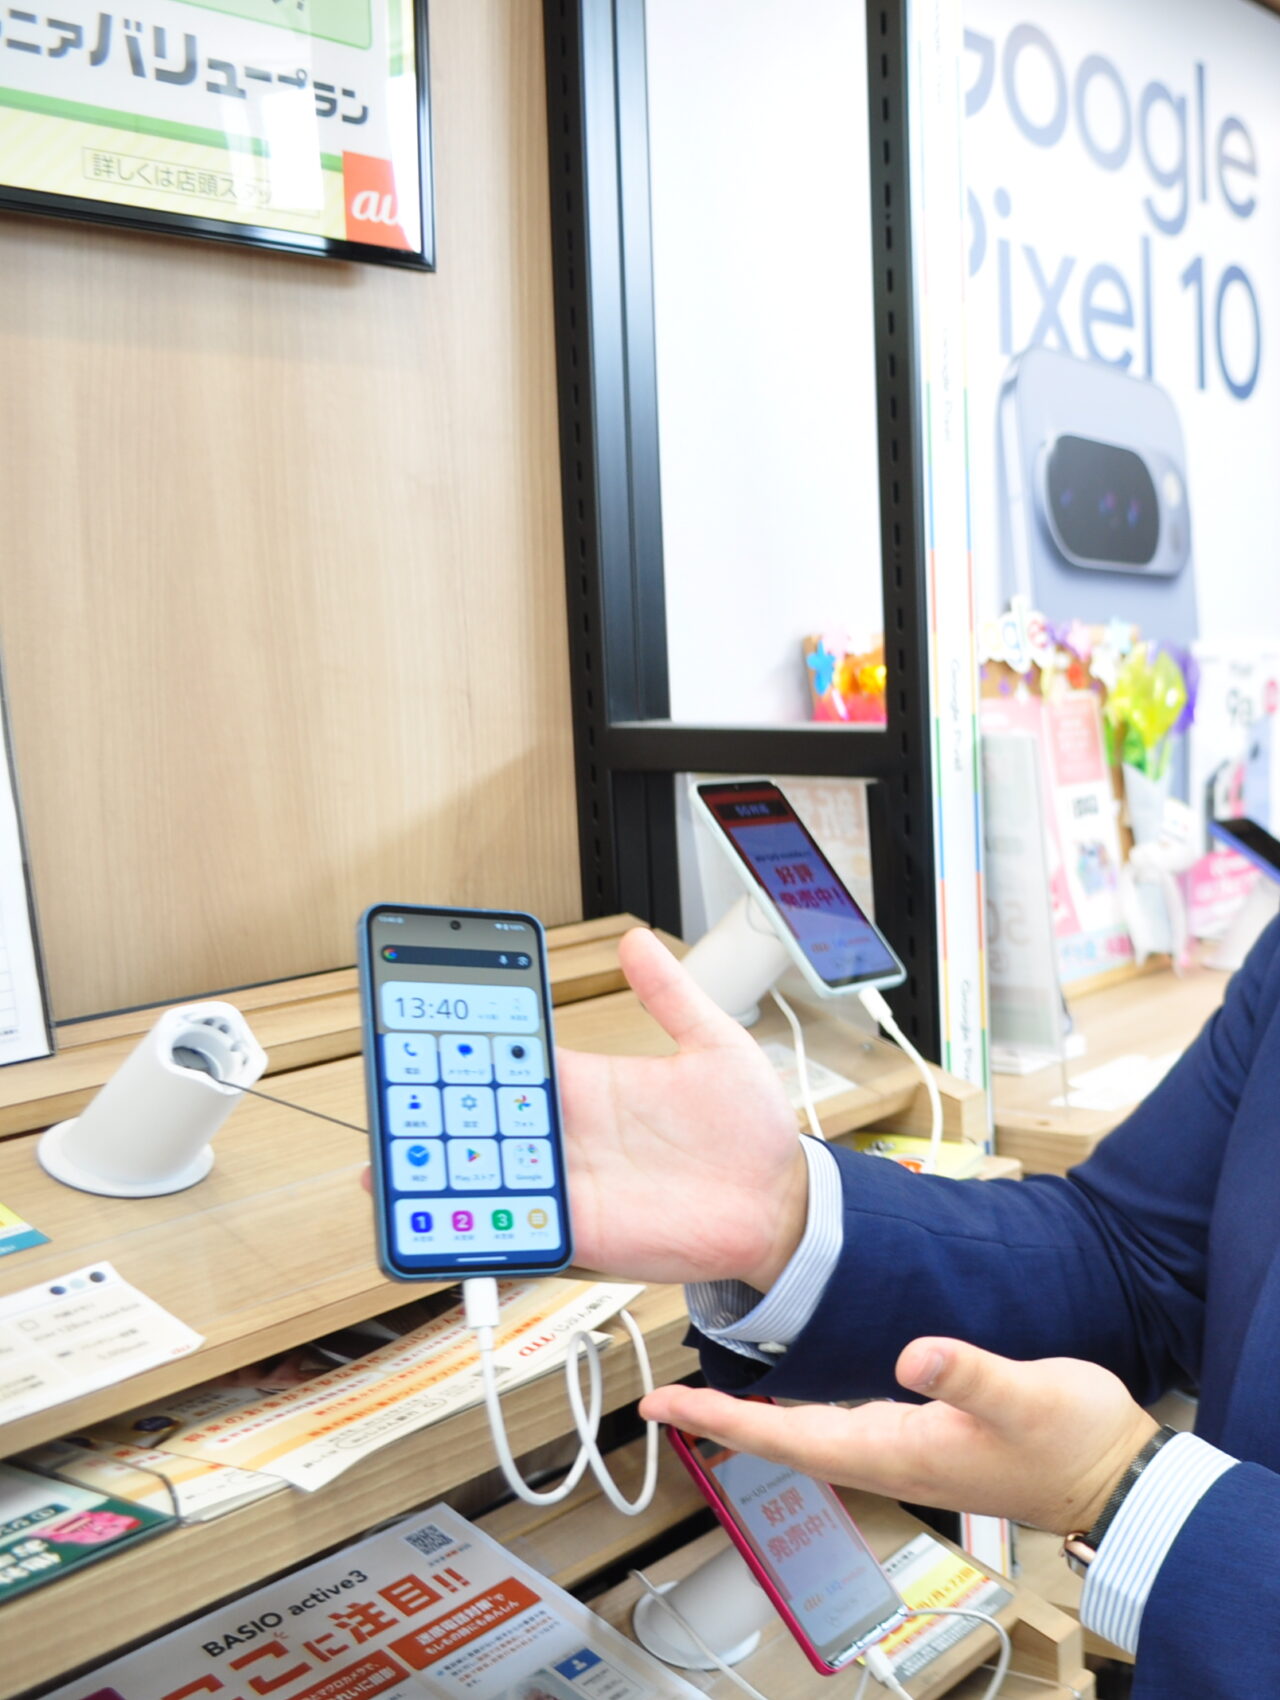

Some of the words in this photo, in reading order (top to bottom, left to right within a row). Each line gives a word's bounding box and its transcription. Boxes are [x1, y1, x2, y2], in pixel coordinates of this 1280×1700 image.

[0, 9, 369, 126] ニアバリュープラン
[352, 189, 407, 227] au
[967, 186, 1152, 382] ixel
[1180, 255, 1262, 401] 10
[395, 997, 470, 1020] 13:40
[201, 1611, 284, 1658] BASIO
[288, 1569, 369, 1617] active3
